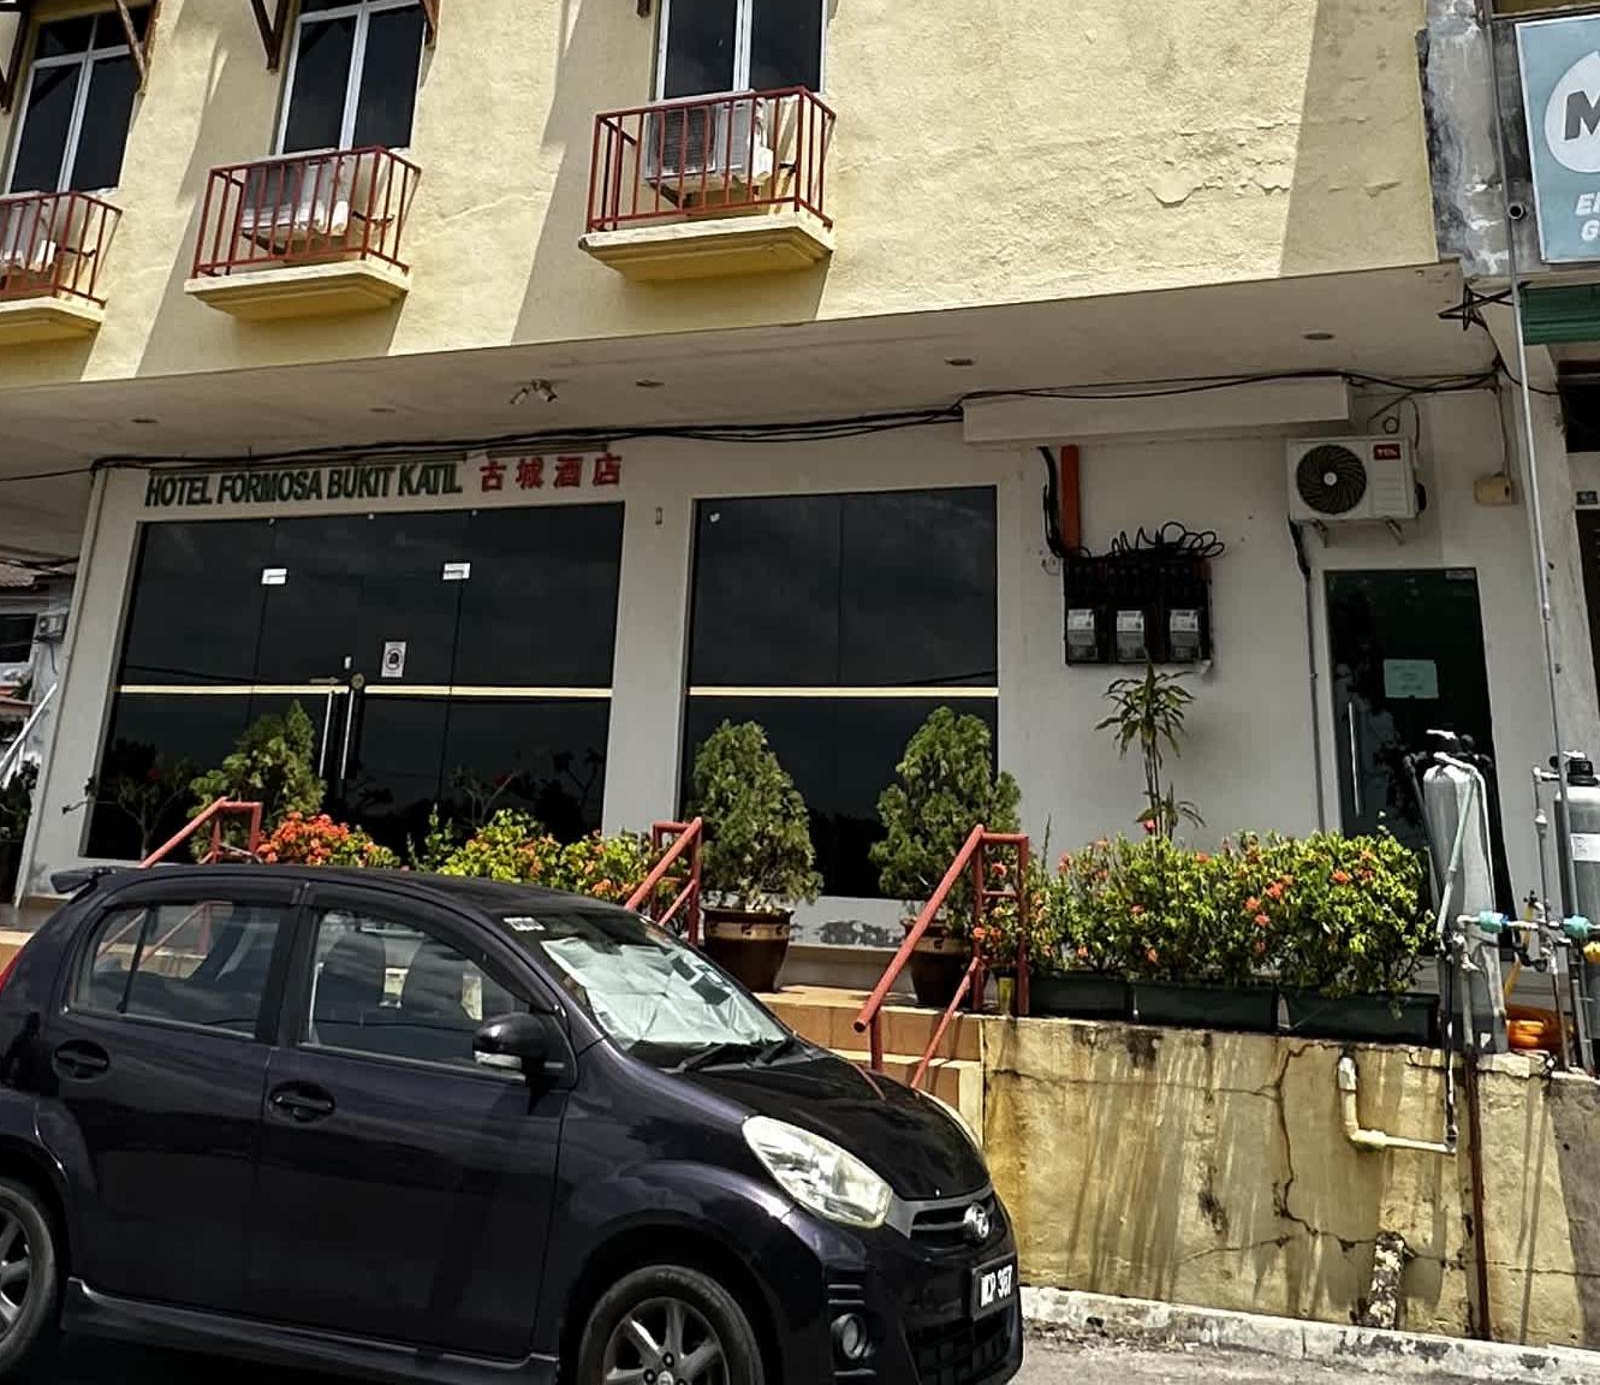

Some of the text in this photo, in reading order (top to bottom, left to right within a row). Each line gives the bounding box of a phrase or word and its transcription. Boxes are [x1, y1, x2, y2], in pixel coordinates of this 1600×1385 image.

[145, 462, 463, 507] HOTEL FORMOSA BUKIT KATIL
[479, 453, 622, 493] 古城酒店
